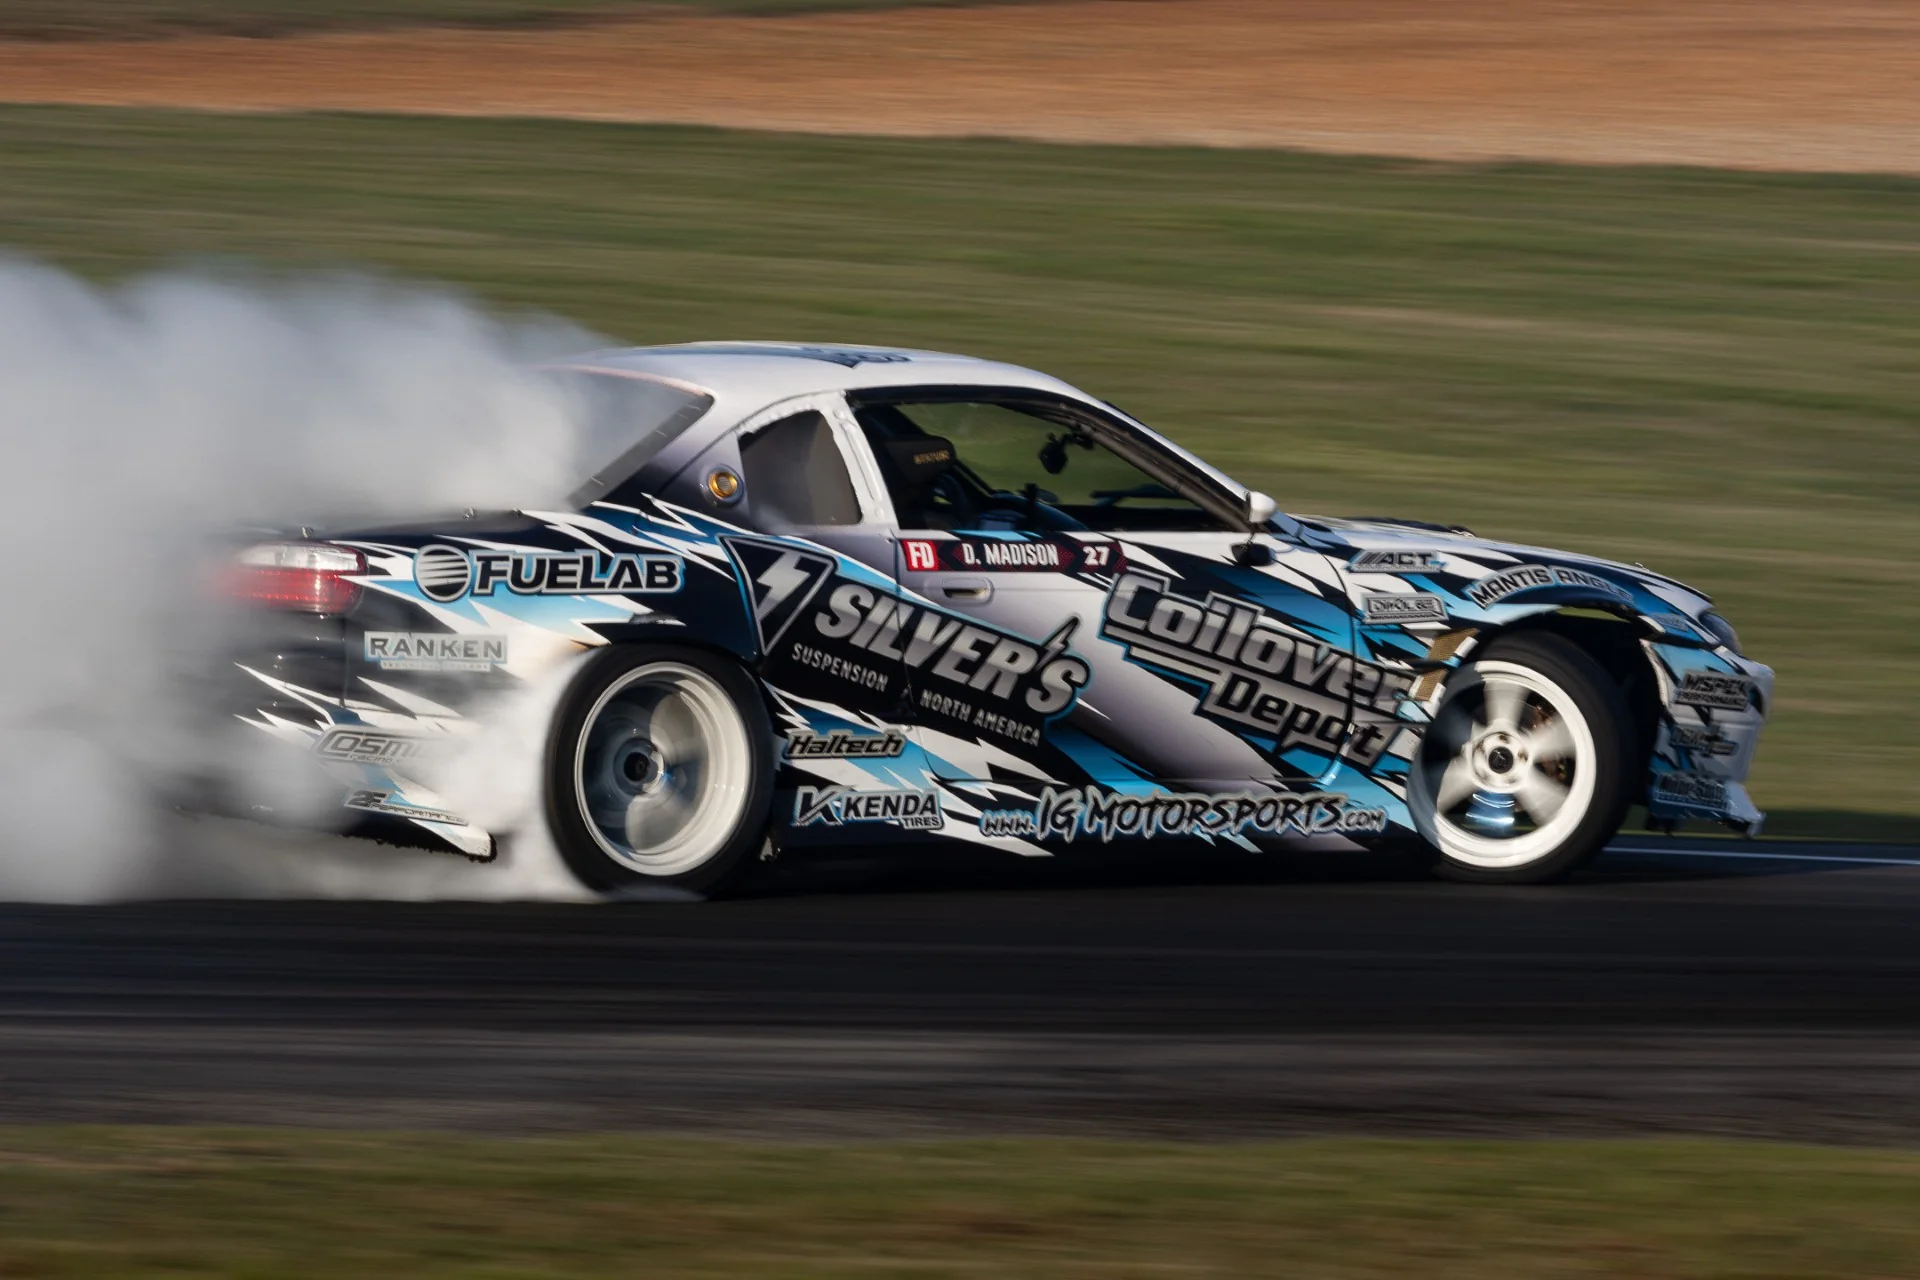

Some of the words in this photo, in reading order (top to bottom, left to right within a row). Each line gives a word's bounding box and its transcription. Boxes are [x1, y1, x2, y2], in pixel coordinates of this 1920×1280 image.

[907, 541, 935, 568] FD
[961, 543, 981, 565] D.
[984, 543, 1060, 566] MADISON
[1082, 546, 1110, 566] 27
[474, 552, 680, 591] FUELAB
[1469, 566, 1552, 606] MANTIS
[369, 637, 503, 659] RANKEN
[1105, 572, 1414, 714] Coilover
[791, 642, 889, 693] SUSPENSION
[918, 688, 973, 722] NORTH
[973, 711, 1042, 748] AMERICA
[1214, 670, 1385, 758] Depot
[786, 732, 905, 757] Haltech
[842, 793, 938, 819] KENDA
[903, 815, 940, 829] TIRES
